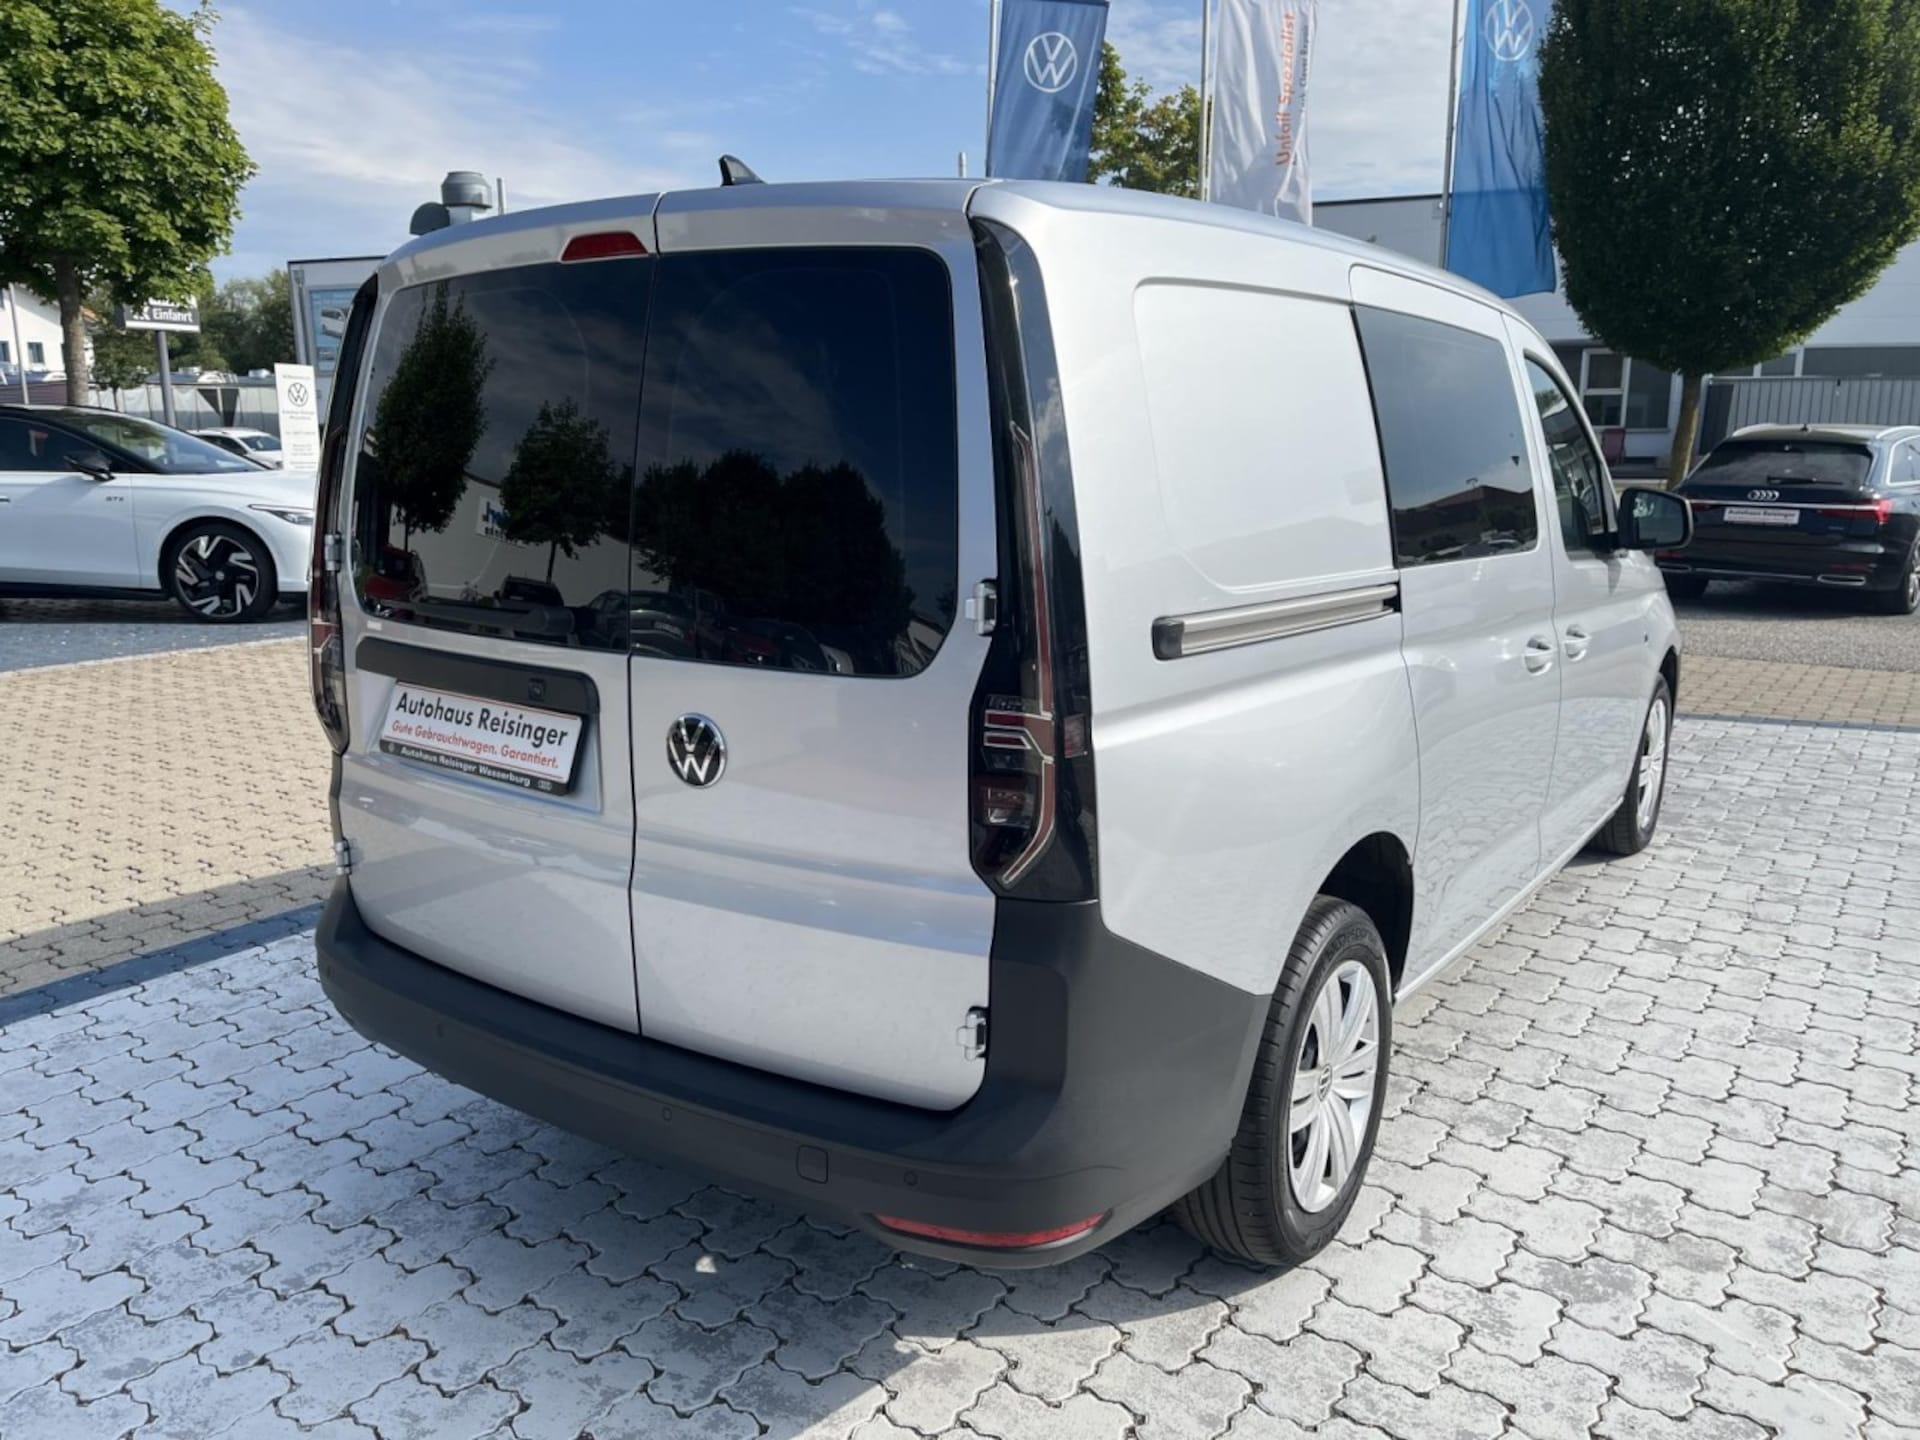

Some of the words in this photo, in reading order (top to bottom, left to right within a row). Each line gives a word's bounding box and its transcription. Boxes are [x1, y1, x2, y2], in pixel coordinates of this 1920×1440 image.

[1024, 32, 1077, 93] VW
[1277, 12, 1296, 106] Spezialist
[1275, 112, 1292, 166] Unfall
[392, 720, 413, 735] Gute
[500, 744, 559, 769] Garantiert.
[396, 691, 474, 726] Autohaus
[478, 708, 568, 748] Reisinger
[401, 746, 438, 763] Autohaus
[439, 756, 478, 773] Reisinger
[478, 764, 531, 787] Wasserburg
[667, 713, 727, 788] VW
